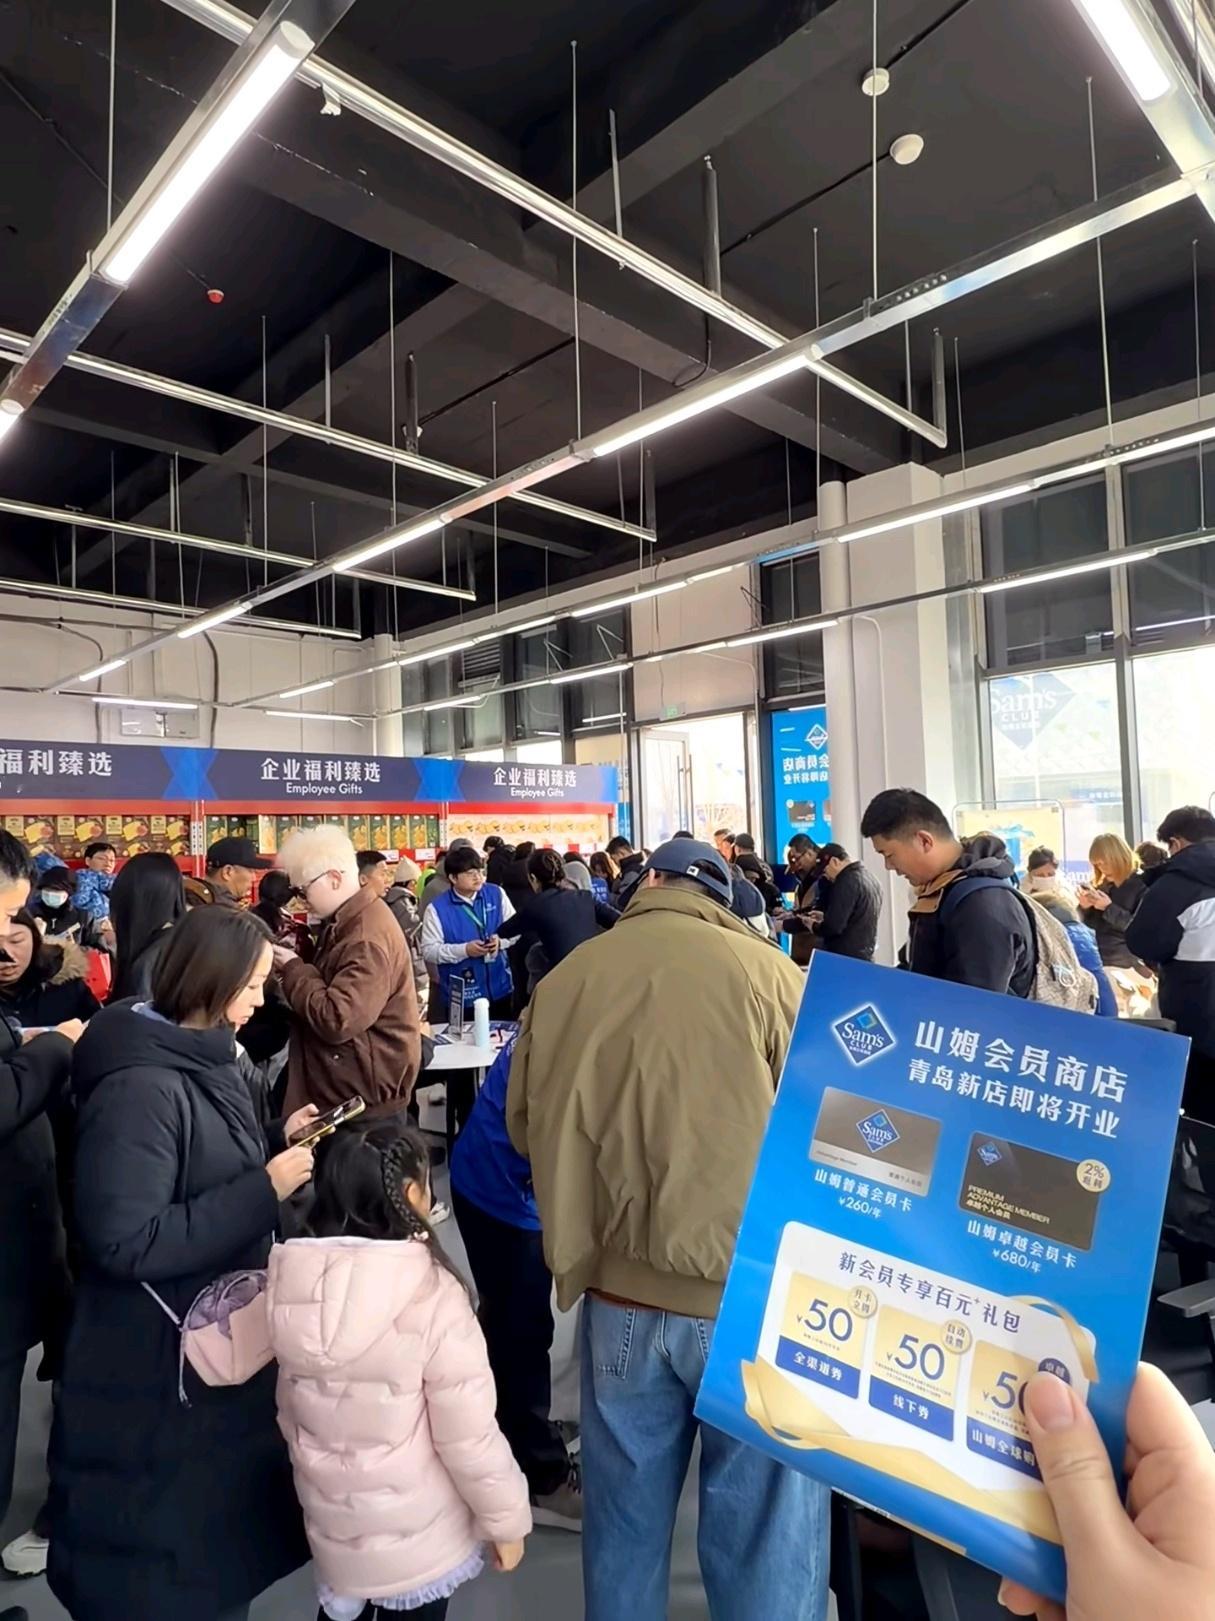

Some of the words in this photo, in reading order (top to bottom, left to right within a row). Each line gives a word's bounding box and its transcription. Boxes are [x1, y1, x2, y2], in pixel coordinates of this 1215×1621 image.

[0, 749, 113, 777] 福利臻选
[260, 758, 381, 783] 企业福利臻选
[286, 782, 336, 796] Employee
[338, 783, 363, 795] Gifts
[493, 767, 577, 787] 企业福利臻选
[510, 787, 546, 799] Employee
[547, 788, 565, 797] Gifts
[841, 1022, 885, 1048] Sam's
[914, 1020, 1128, 1103] 山姆会员商店
[908, 1058, 1120, 1138] 青岛新店即将开业
[863, 1121, 893, 1141] Sam's
[1084, 1163, 1105, 1179] 2%
[814, 1168, 912, 1212] 山姆普通会员卡
[968, 1185, 1005, 1202] PREMIUM
[967, 1192, 1015, 1213] ADVANTAGE
[1014, 1207, 1051, 1225] MEMBER
[967, 1219, 1078, 1269] 山姆卓越会员卡
[793, 1351, 843, 1382] 全渠道券
[892, 1393, 930, 1420] 线下券
